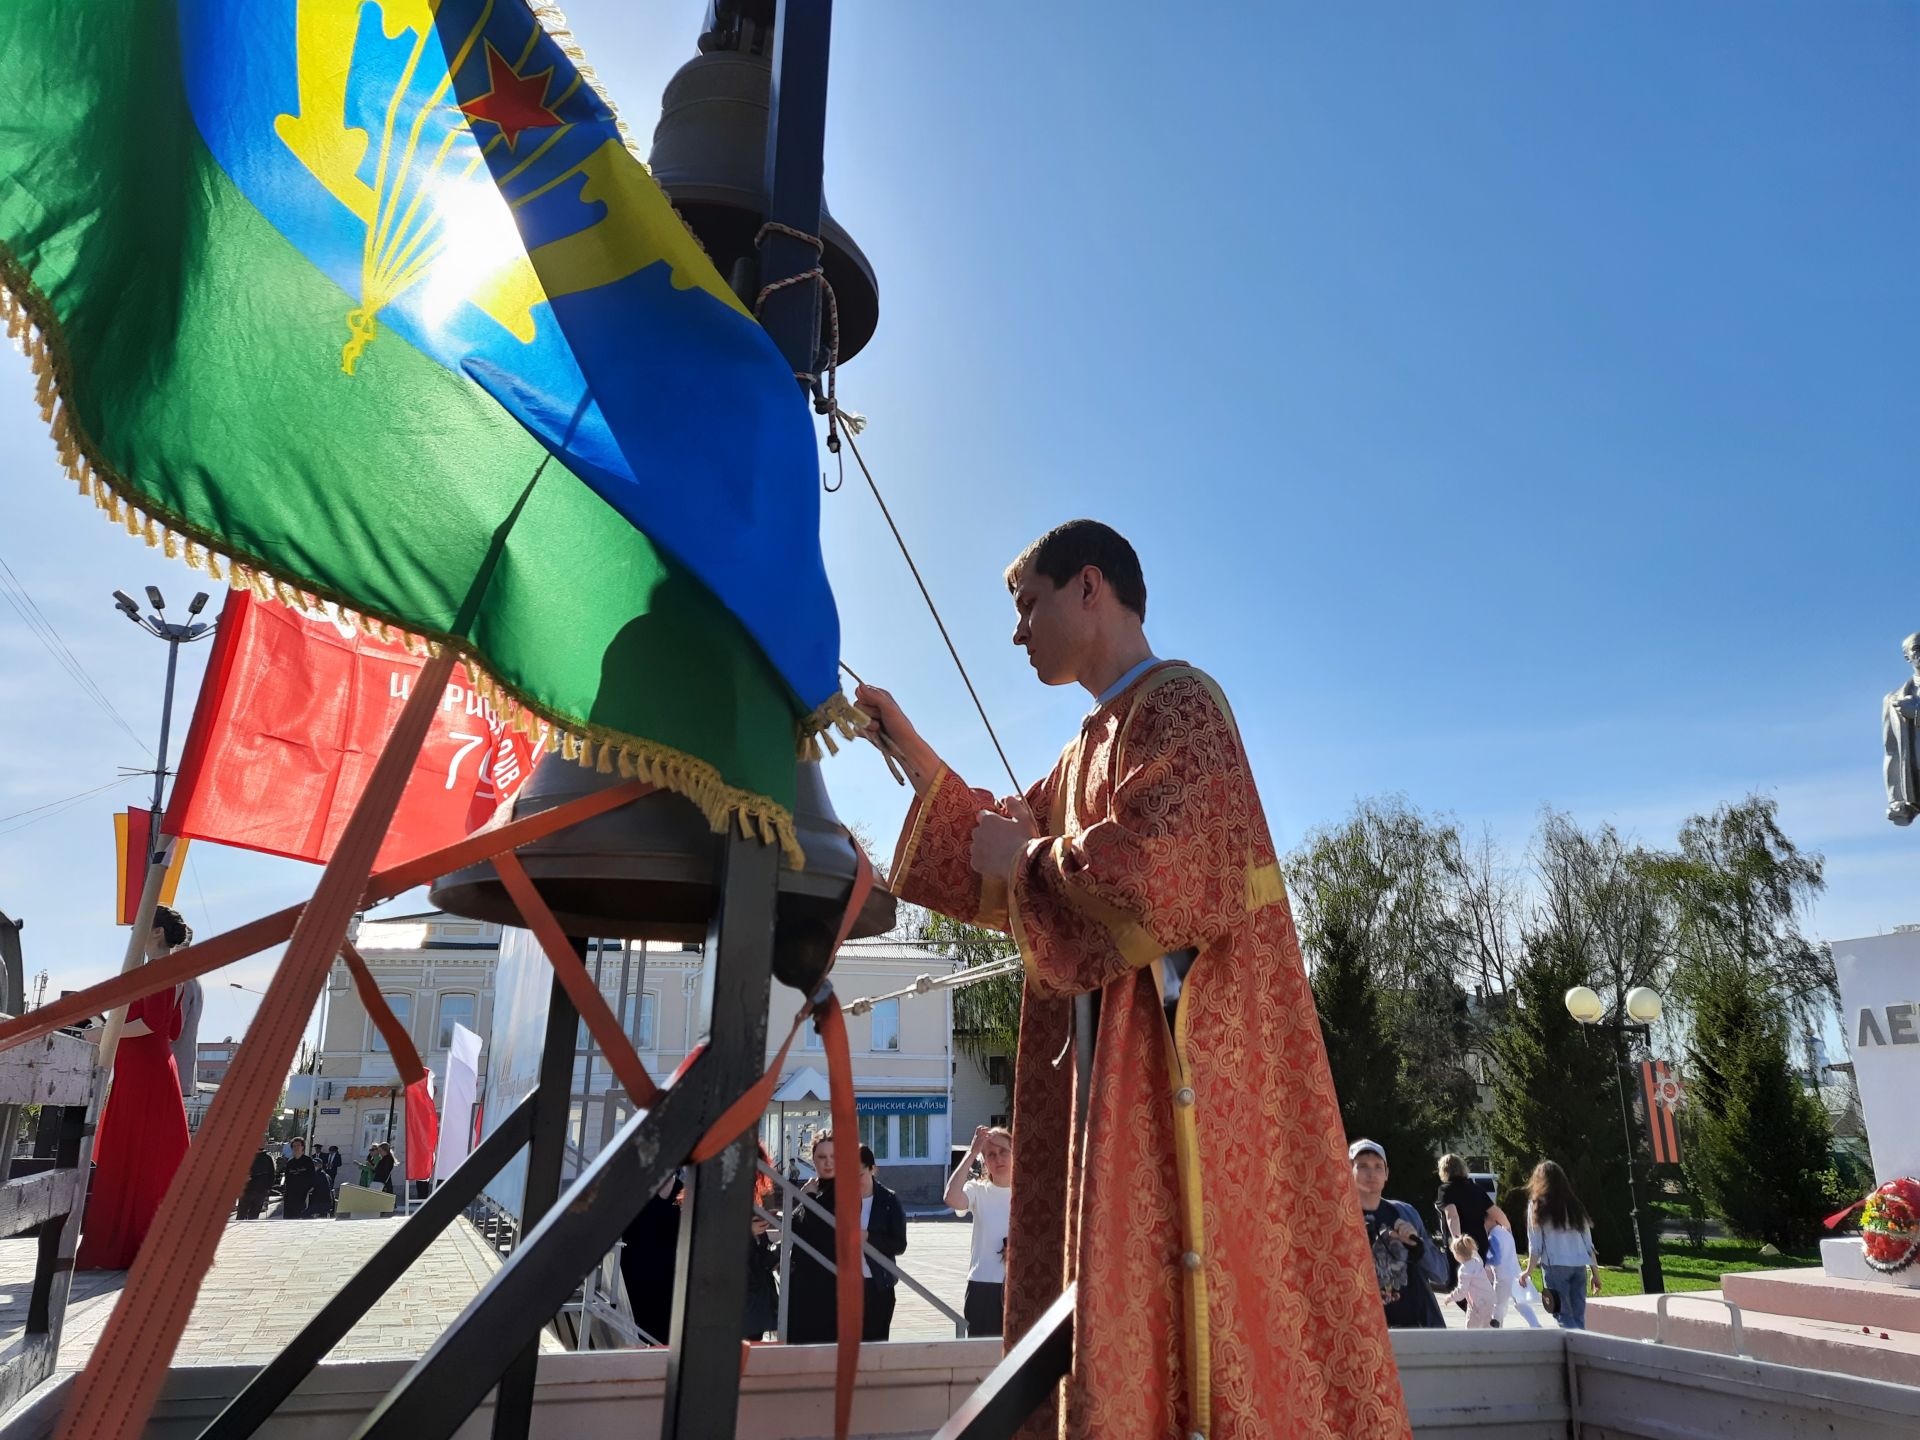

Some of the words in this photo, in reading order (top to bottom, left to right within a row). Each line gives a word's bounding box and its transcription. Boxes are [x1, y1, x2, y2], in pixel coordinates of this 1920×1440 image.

[1858, 1004, 1920, 1047] ЛЕ
[856, 1102, 905, 1111] ДИЦИНСКИЕ
[907, 1101, 945, 1110] АНАЛИЗЫ
